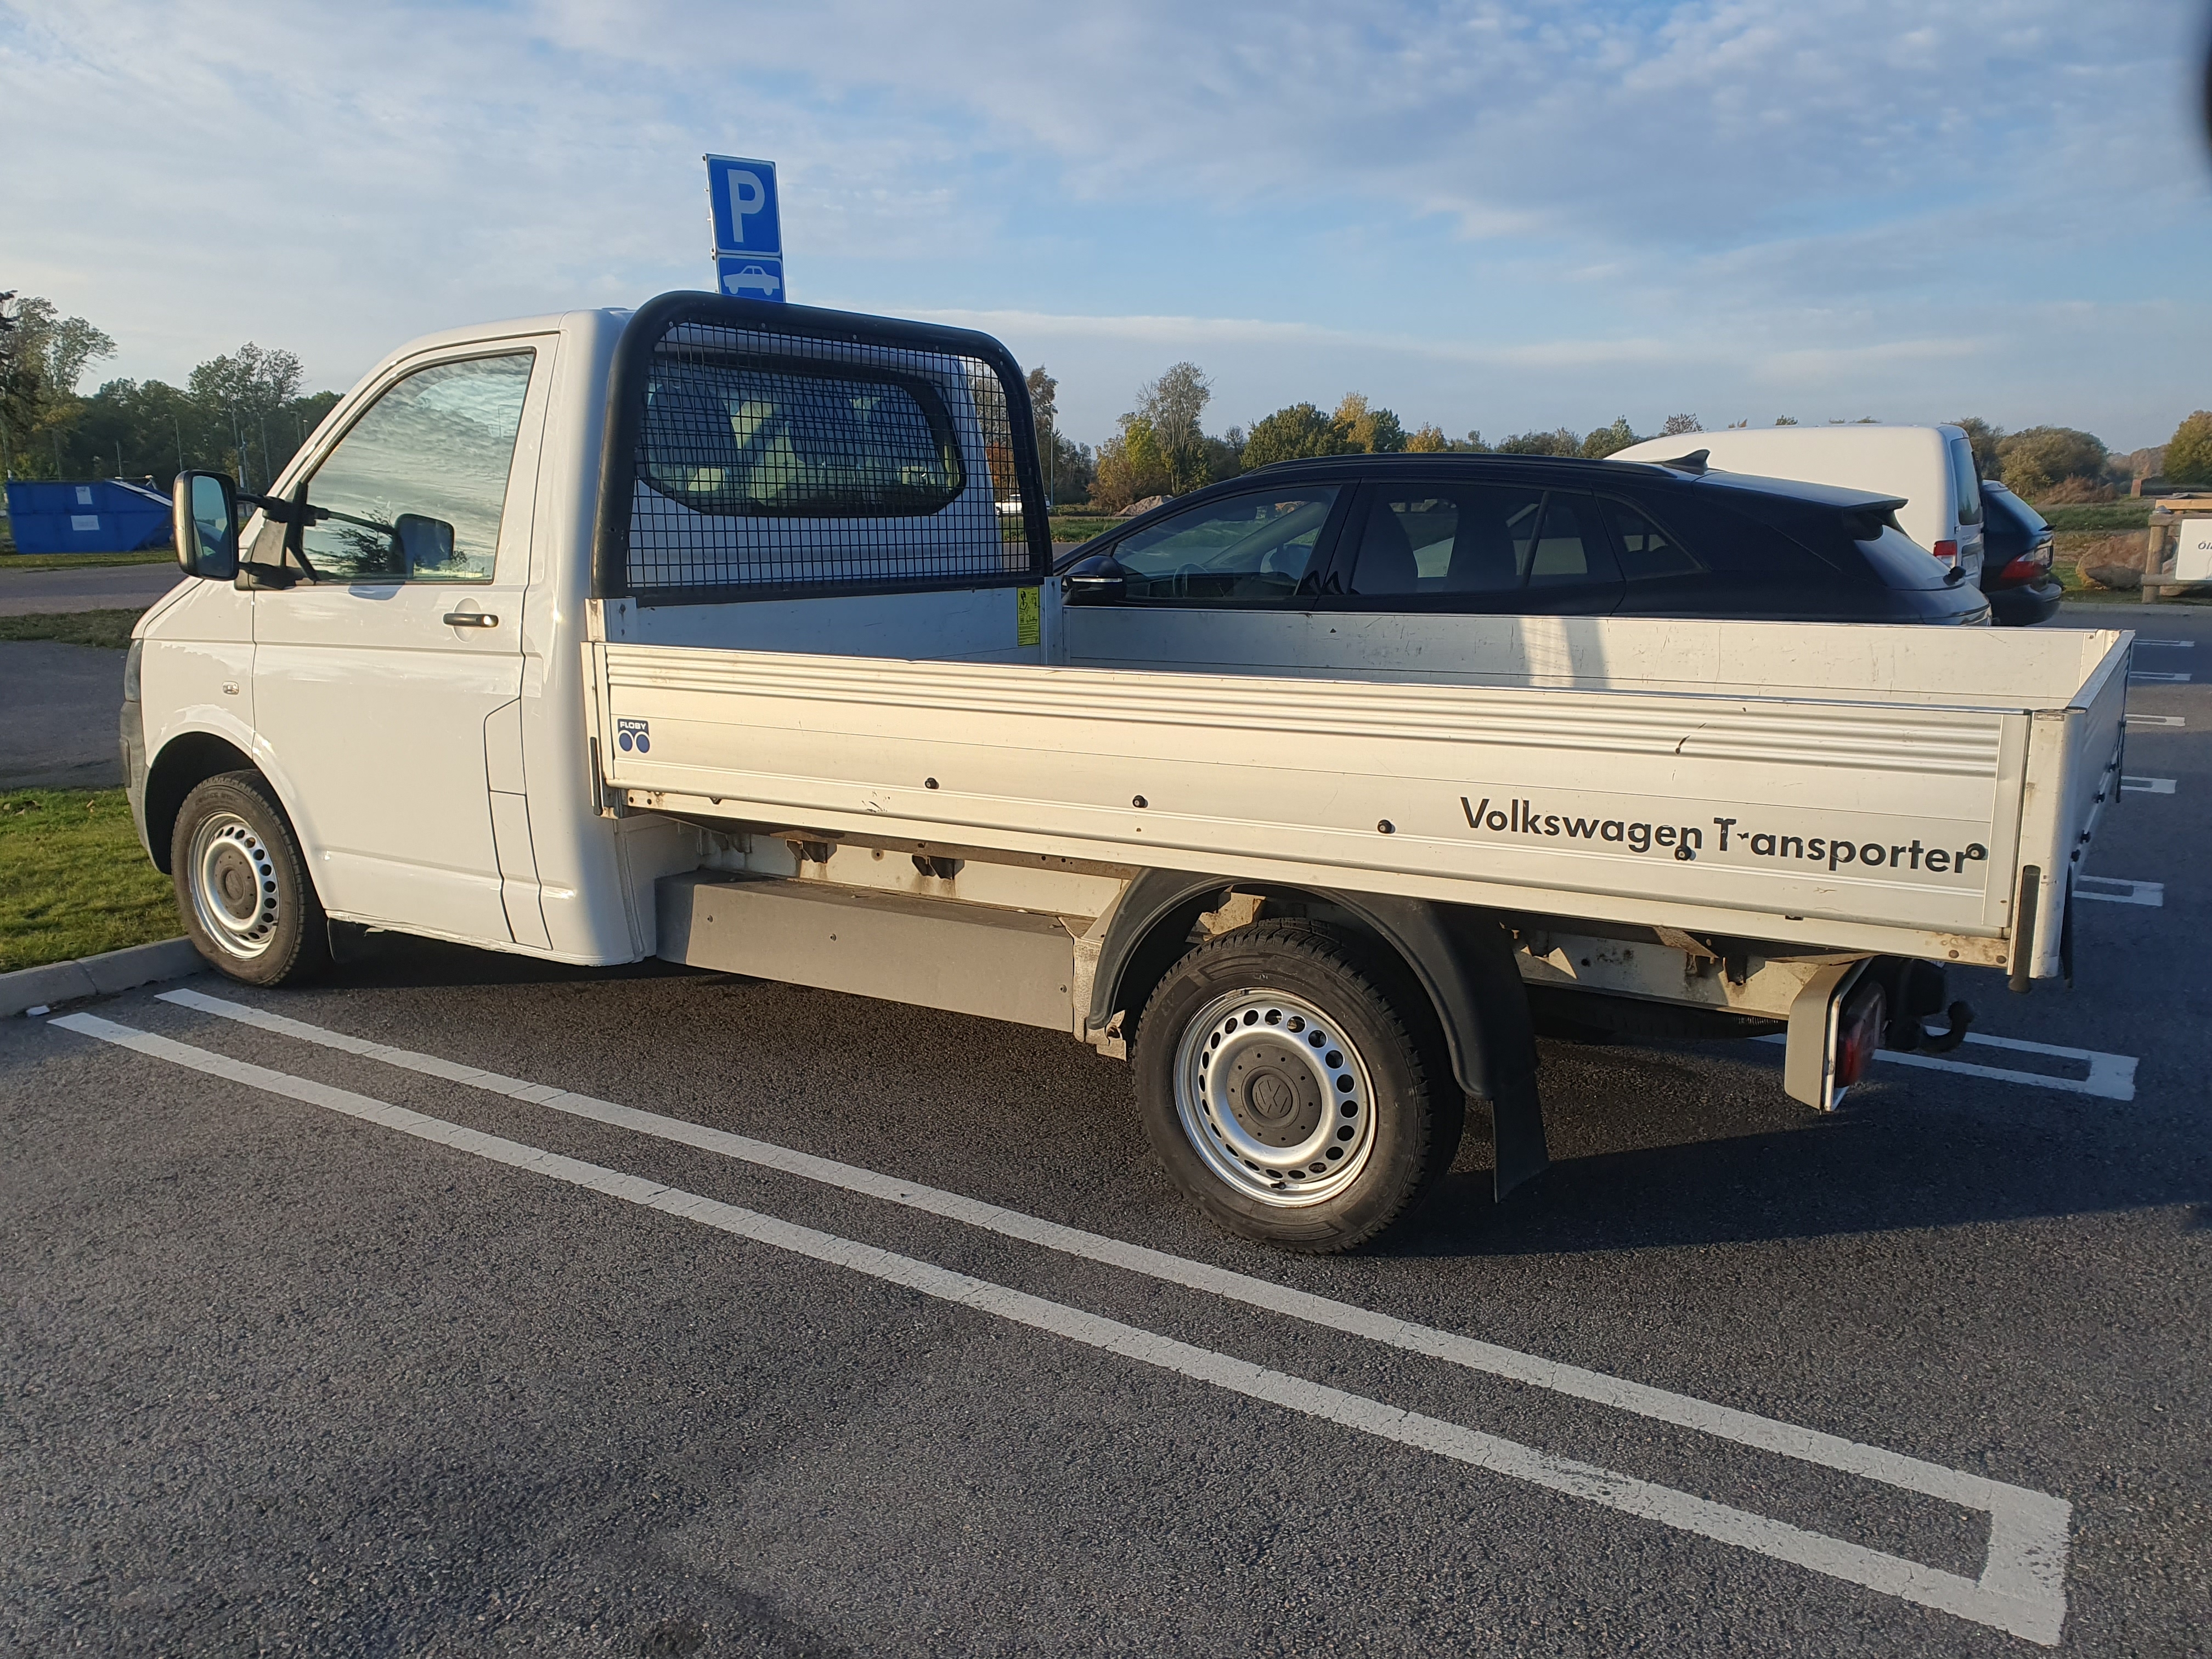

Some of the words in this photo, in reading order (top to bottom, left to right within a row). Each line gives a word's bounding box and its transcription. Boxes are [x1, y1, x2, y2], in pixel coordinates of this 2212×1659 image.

[727, 168, 765, 242] P
[620, 721, 646, 730] FLOBY
[1460, 797, 1702, 853] Volkswagen
